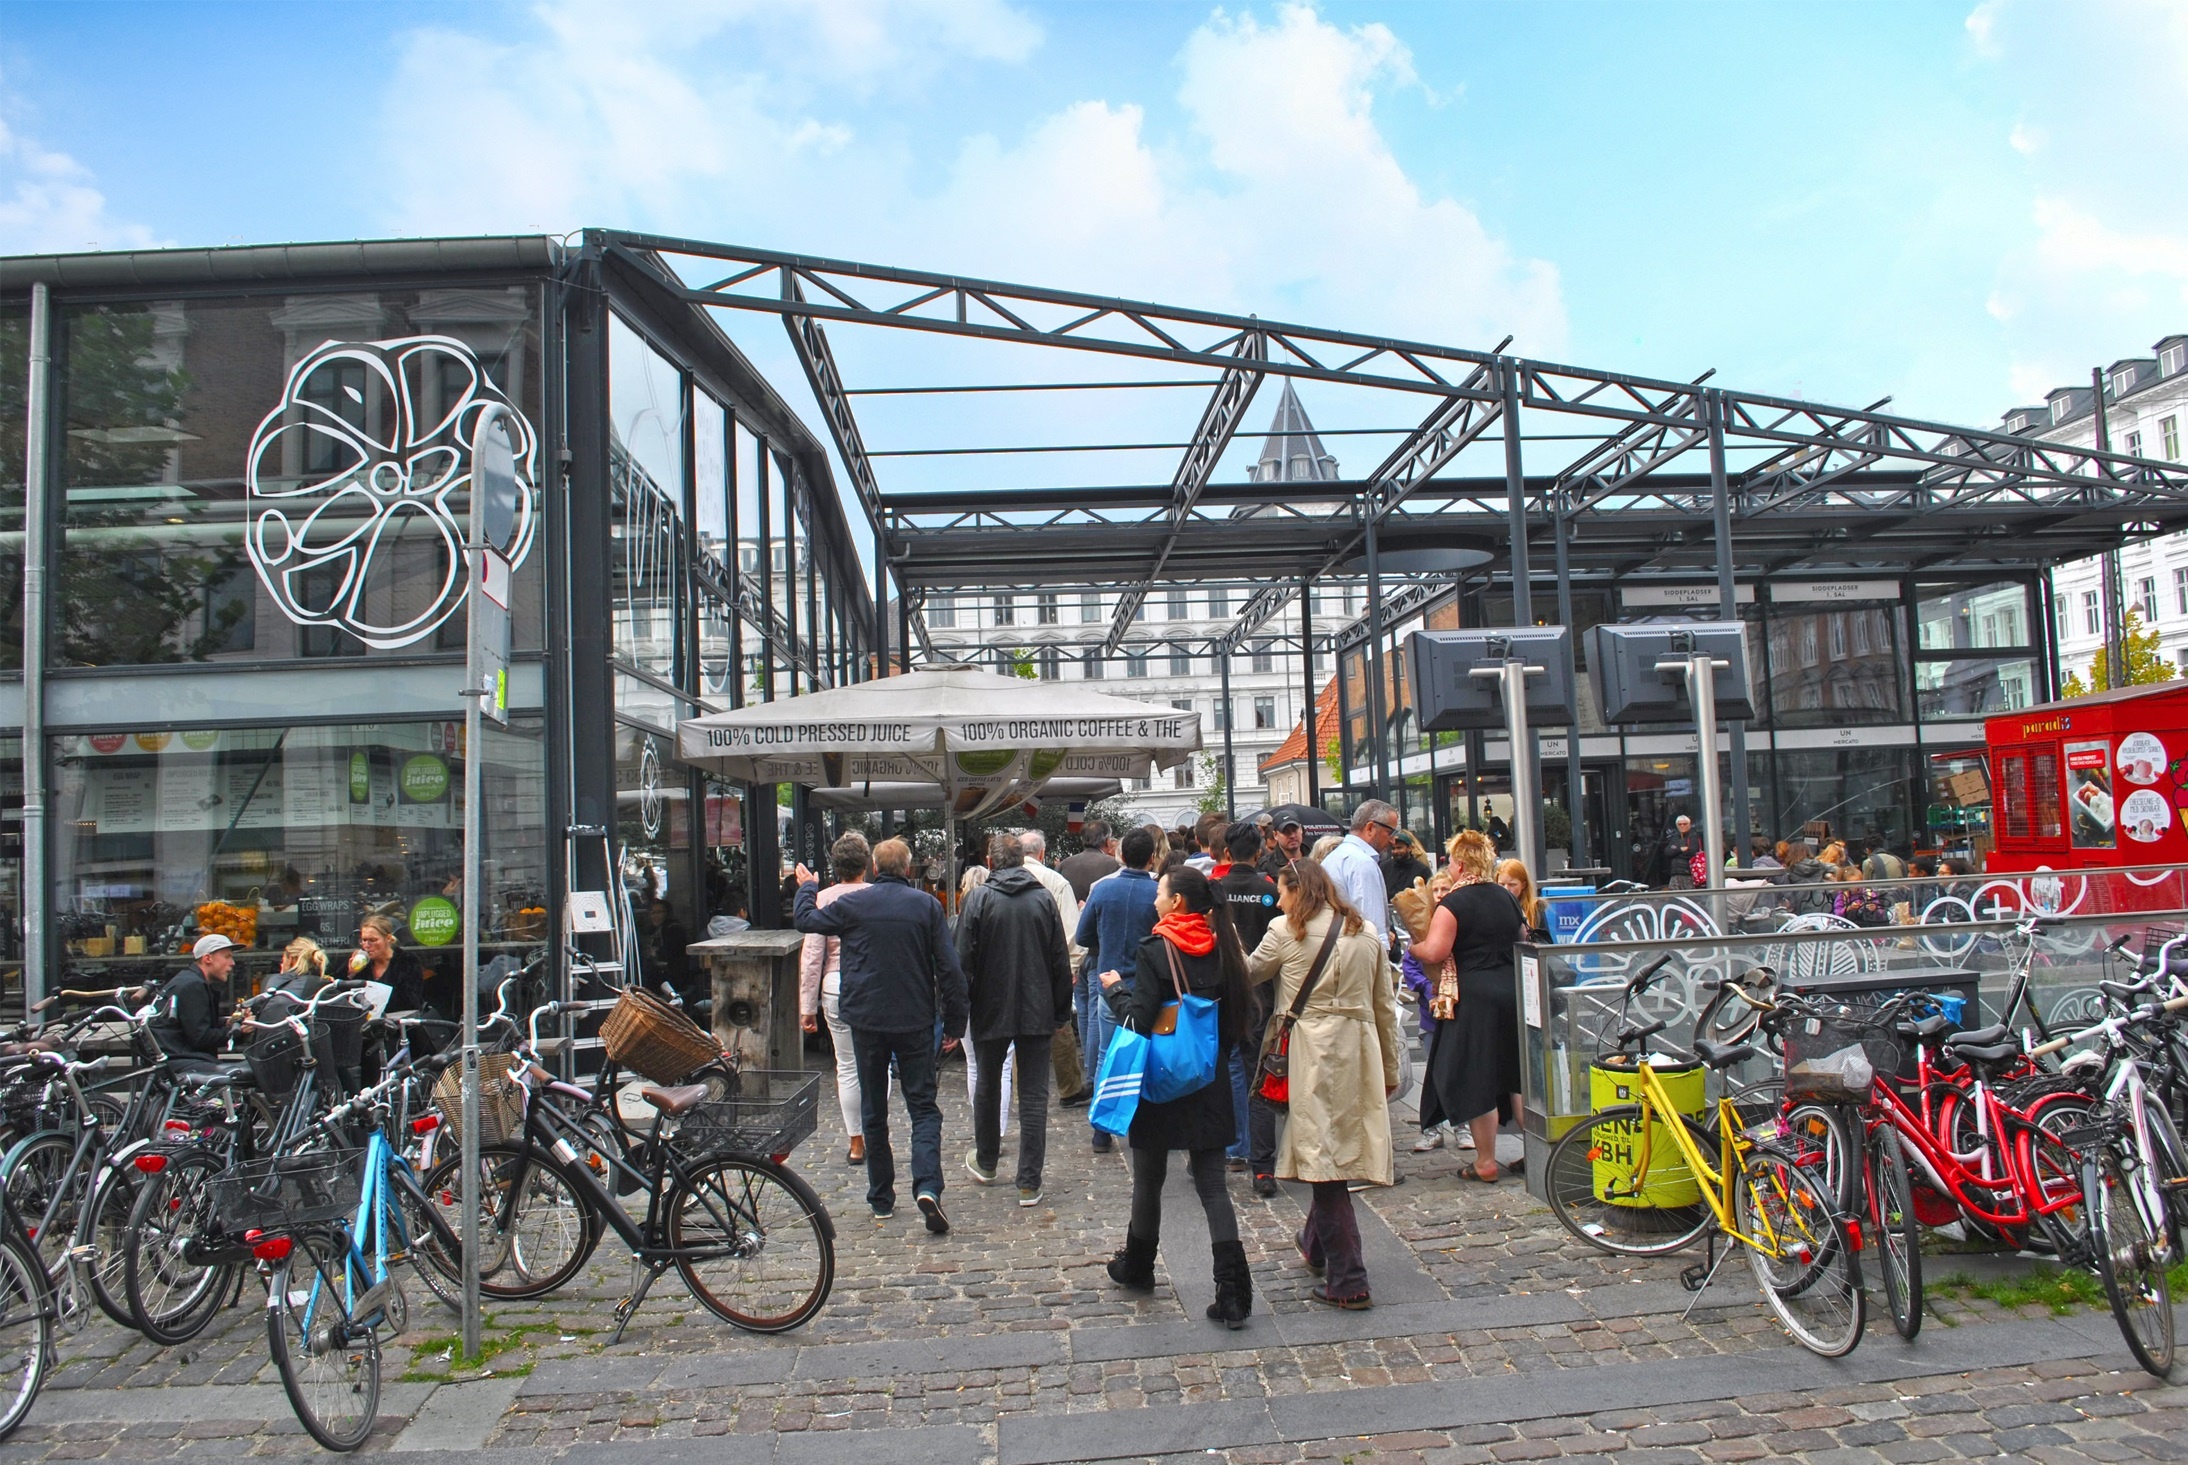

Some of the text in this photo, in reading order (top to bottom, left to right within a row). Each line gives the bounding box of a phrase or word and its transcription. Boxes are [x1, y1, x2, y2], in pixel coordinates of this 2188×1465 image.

[961, 719, 1182, 741] 100% ORGANIC COFFEE & THE
[2023, 716, 2071, 739] paradis
[707, 723, 912, 747] 100% COLD PRESSED JUICE
[407, 766, 442, 775] UNPLUGGED
[405, 774, 444, 786] juice
[1227, 893, 1261, 903] LIANCE
[302, 900, 349, 911] EGG WRAPS
[414, 918, 454, 930] juice
[1559, 916, 1580, 926] mx
